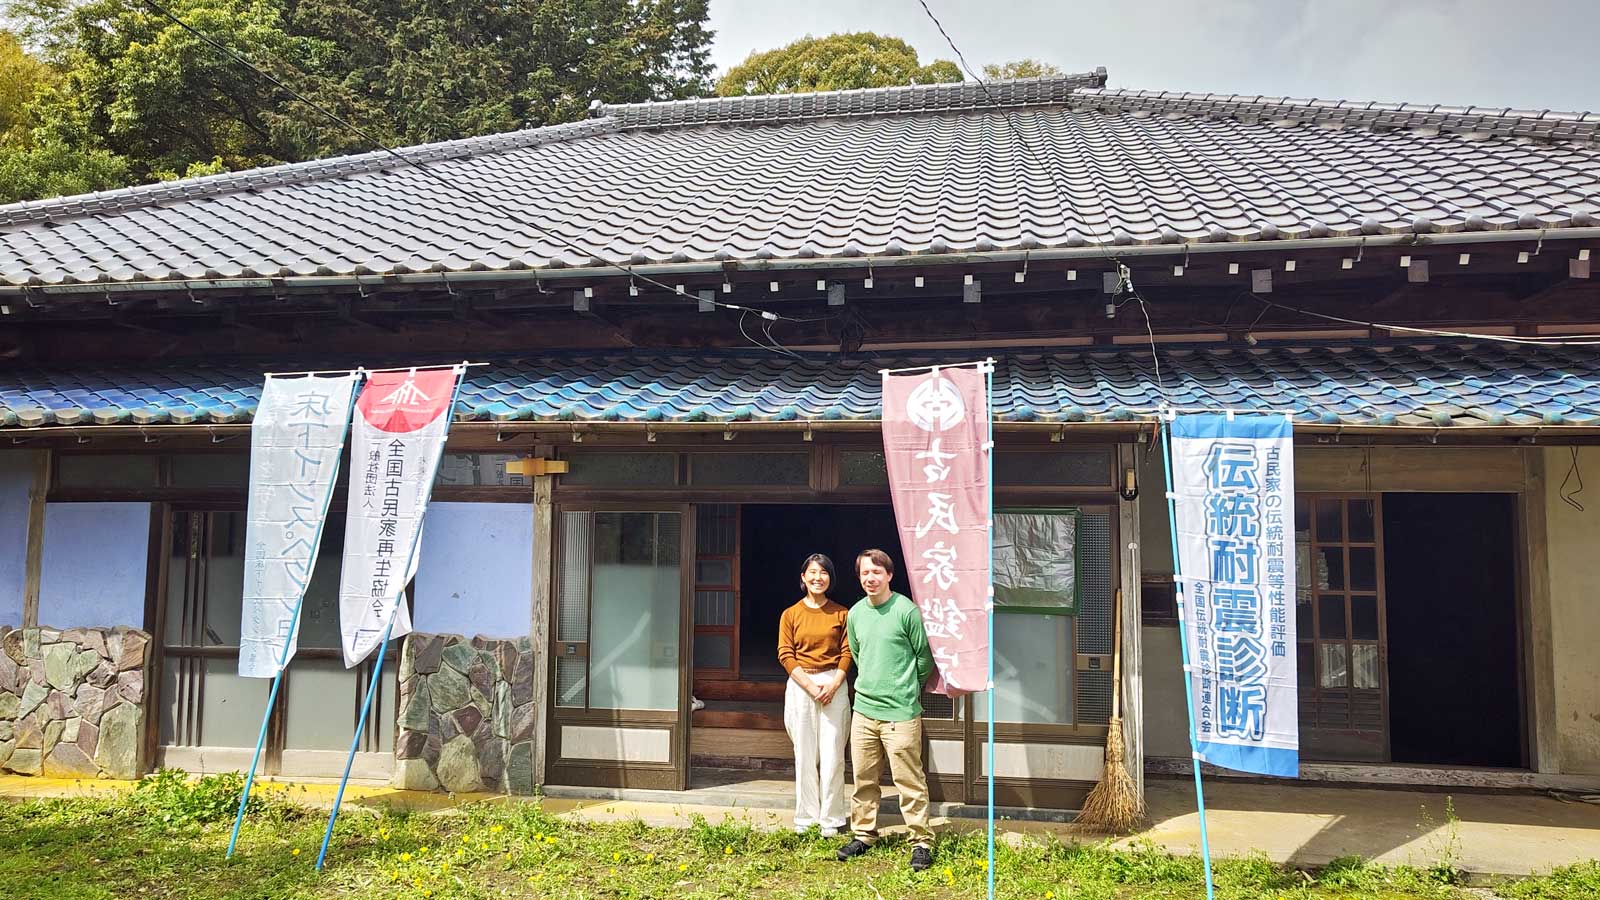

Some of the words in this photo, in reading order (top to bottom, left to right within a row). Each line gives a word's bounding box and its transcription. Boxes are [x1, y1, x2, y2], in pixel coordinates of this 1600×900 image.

[1194, 582, 1212, 733] 全国伝統耐震診断連合会
[1205, 443, 1267, 741] 伝統耐震診断
[1265, 446, 1287, 658] 古民家の伝統耐震等性能評価
